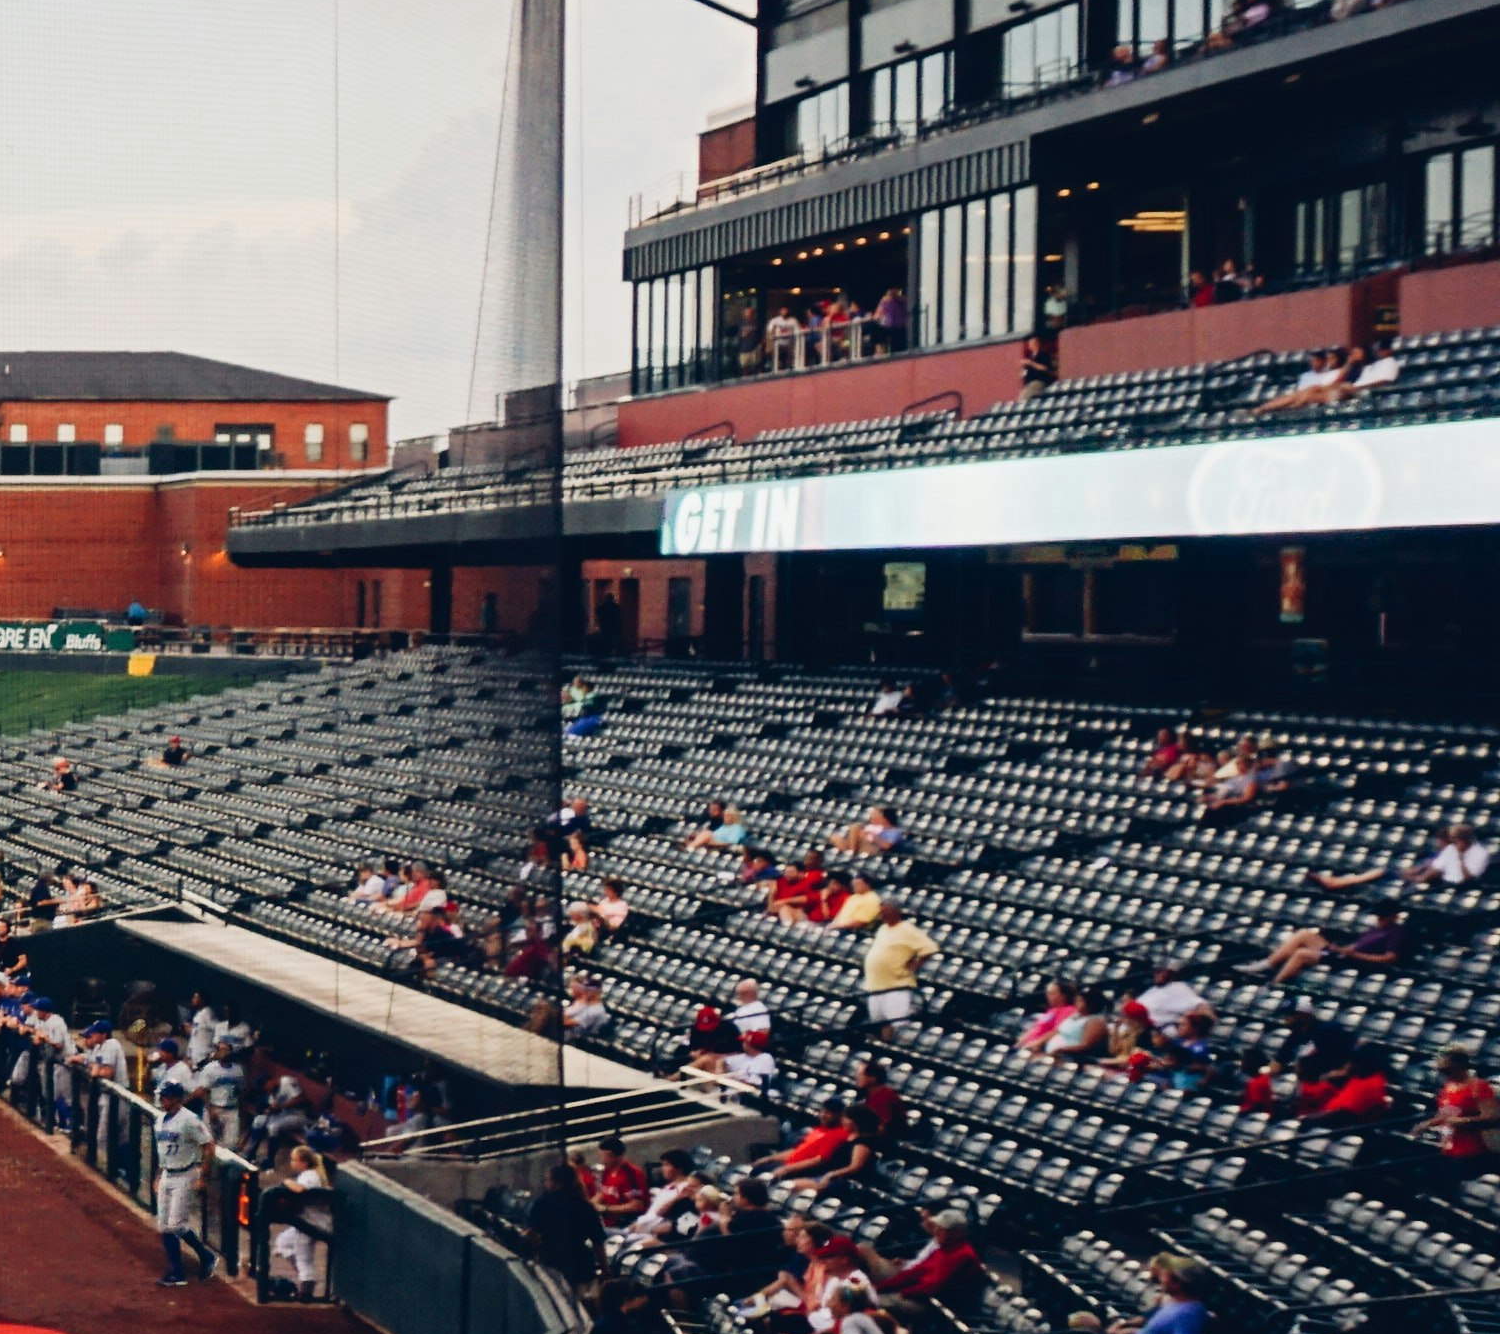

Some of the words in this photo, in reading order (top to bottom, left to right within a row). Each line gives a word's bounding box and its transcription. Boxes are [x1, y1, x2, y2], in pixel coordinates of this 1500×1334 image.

[674, 486, 742, 551] GET
[750, 485, 800, 548] IN
[65, 633, 102, 650] Bluffs
